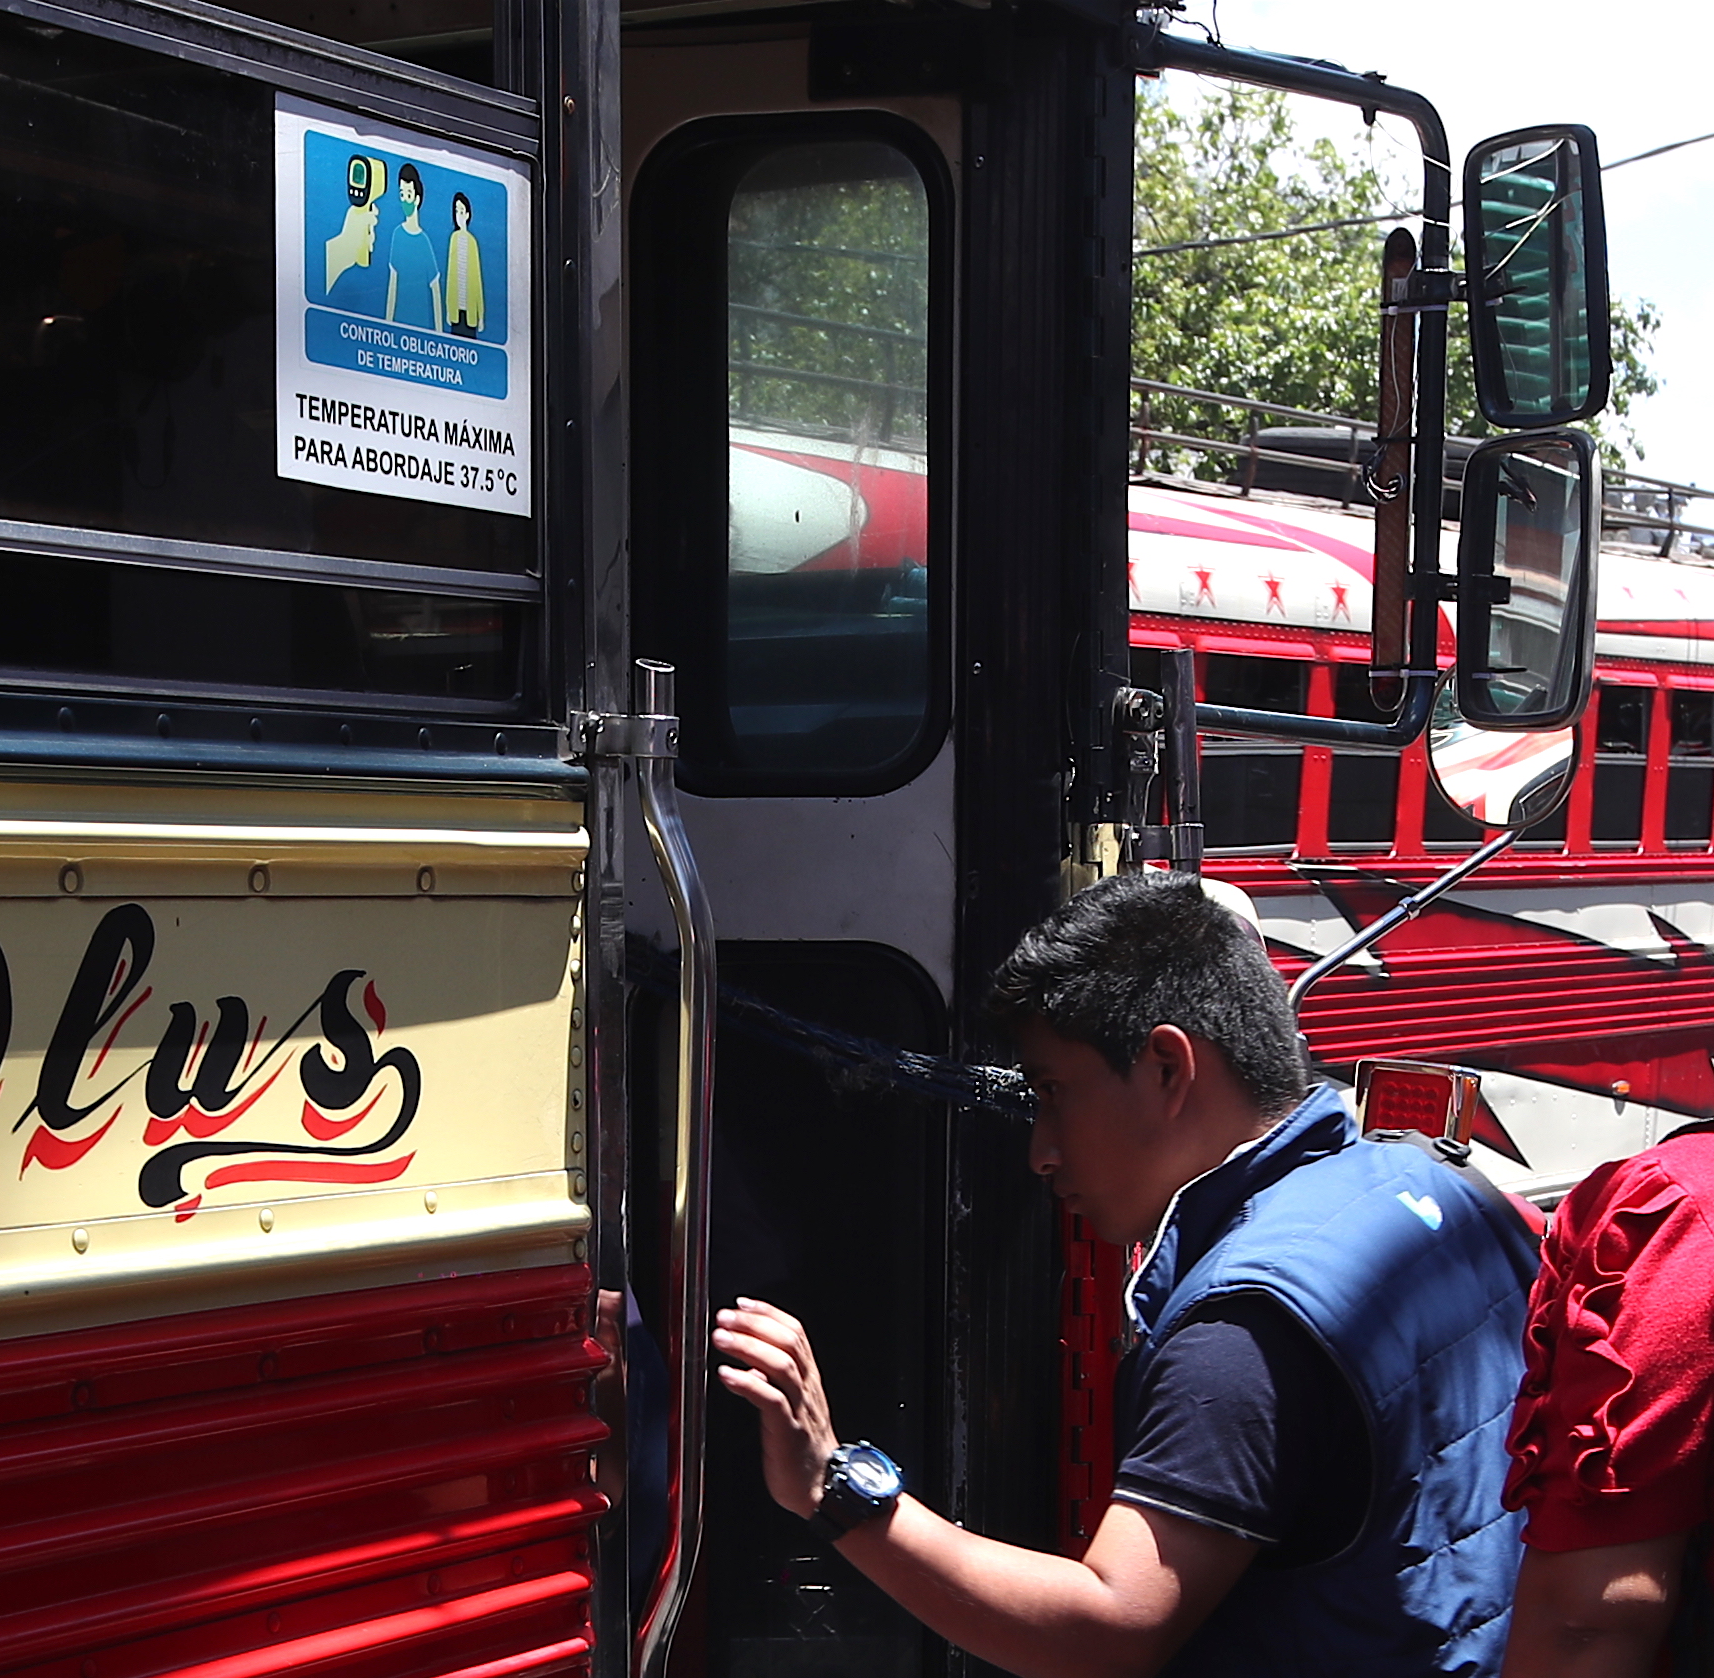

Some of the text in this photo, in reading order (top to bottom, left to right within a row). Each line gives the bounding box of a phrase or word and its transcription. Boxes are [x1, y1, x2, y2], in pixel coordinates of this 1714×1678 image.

[340, 322, 478, 366] CONTROL OBLIGATORIO
[357, 349, 463, 386] DE TEMPERATURA
[295, 393, 516, 457] TEMPERATURA MÁXIMA
[294, 435, 348, 469] PARA
[351, 446, 455, 486] ABORDAJE
